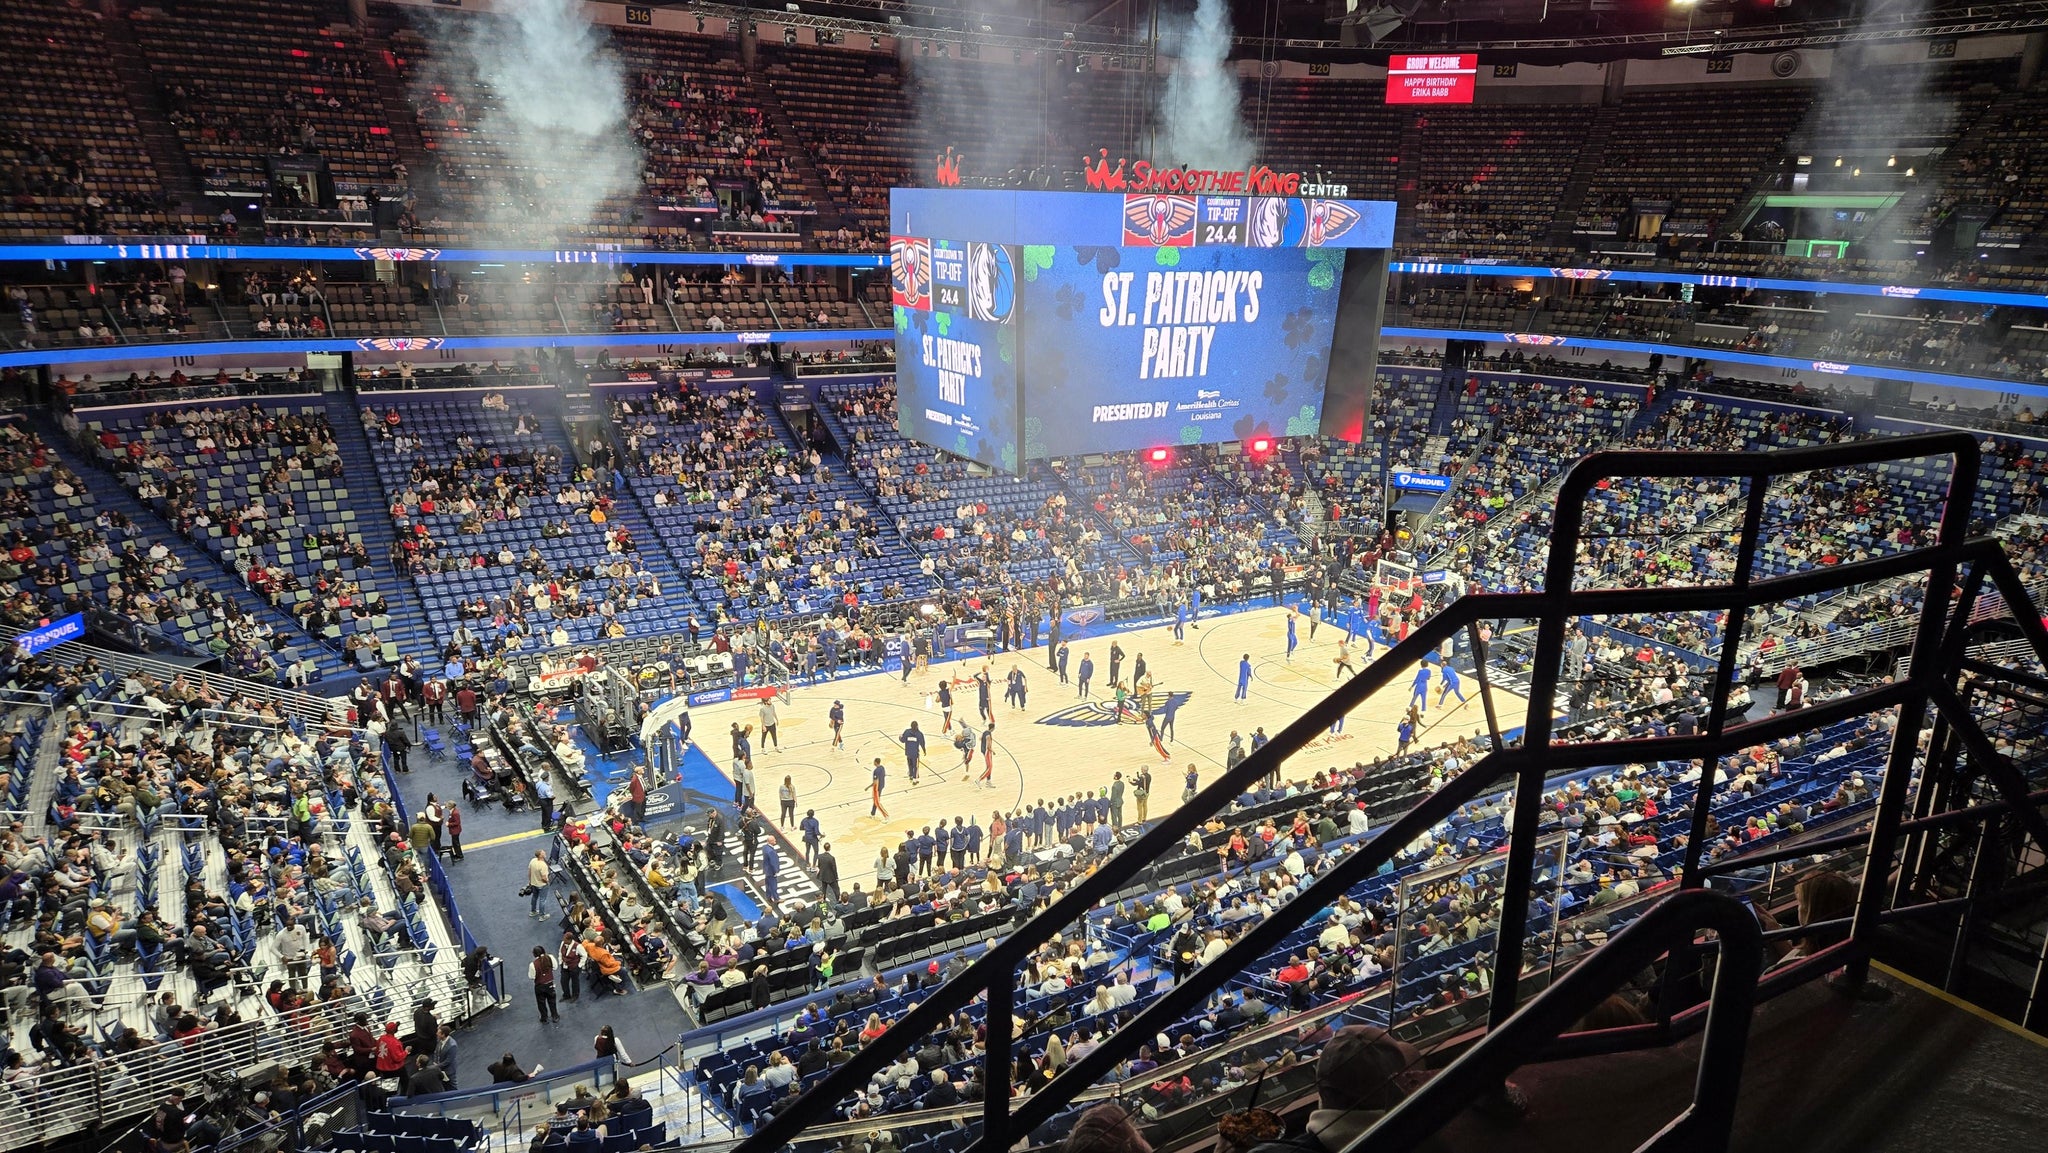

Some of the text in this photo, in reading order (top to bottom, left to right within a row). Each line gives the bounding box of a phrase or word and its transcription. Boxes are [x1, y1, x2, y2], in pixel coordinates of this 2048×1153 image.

[628, 9, 649, 22] 316
[1930, 43, 1955, 56] 323
[1310, 64, 1329, 74] 320
[1406, 56, 1461, 70] GROUP WELCOME
[1709, 61, 1731, 71] 322
[1496, 65, 1515, 76] 321
[1404, 77, 1458, 87] HAPPY BIRTHDAY
[1412, 87, 1449, 97] ERIKA BABB
[212, 179, 229, 187] 313
[1132, 160, 1245, 192] SMOOTHIE
[1300, 184, 1348, 197] CENTER
[343, 183, 358, 191] 314
[1207, 198, 1233, 206] COUNTDOWN
[1207, 207, 1239, 221] TIP-OFF
[1205, 225, 1237, 243] 24.4
[140, 244, 190, 259] GAME
[555, 251, 598, 263] LET'S
[751, 254, 779, 262] Ochsner
[935, 261, 963, 282] TIP-OFF
[1702, 275, 1737, 287] LET'S
[941, 288, 959, 305] 24.4
[1889, 286, 1920, 295] Ochsner
[1099, 270, 1263, 327] ST. PATRICK'S
[743, 332, 771, 340] Ochsner
[922, 334, 982, 378] ST. PATRICK'S
[1139, 325, 1216, 379] PARTY
[1820, 361, 1850, 371] Ochsner
[938, 369, 966, 406] PARTY
[1175, 398, 1240, 410] AmeriHealth Caritas
[1999, 391, 2020, 405] 119
[1092, 401, 1170, 423] PRESENTED BY
[1191, 411, 1222, 421] Louisiana
[1411, 477, 1446, 487] FANDUEL
[33, 621, 79, 646] FANDUEL
[700, 690, 726, 700] Ochsner
